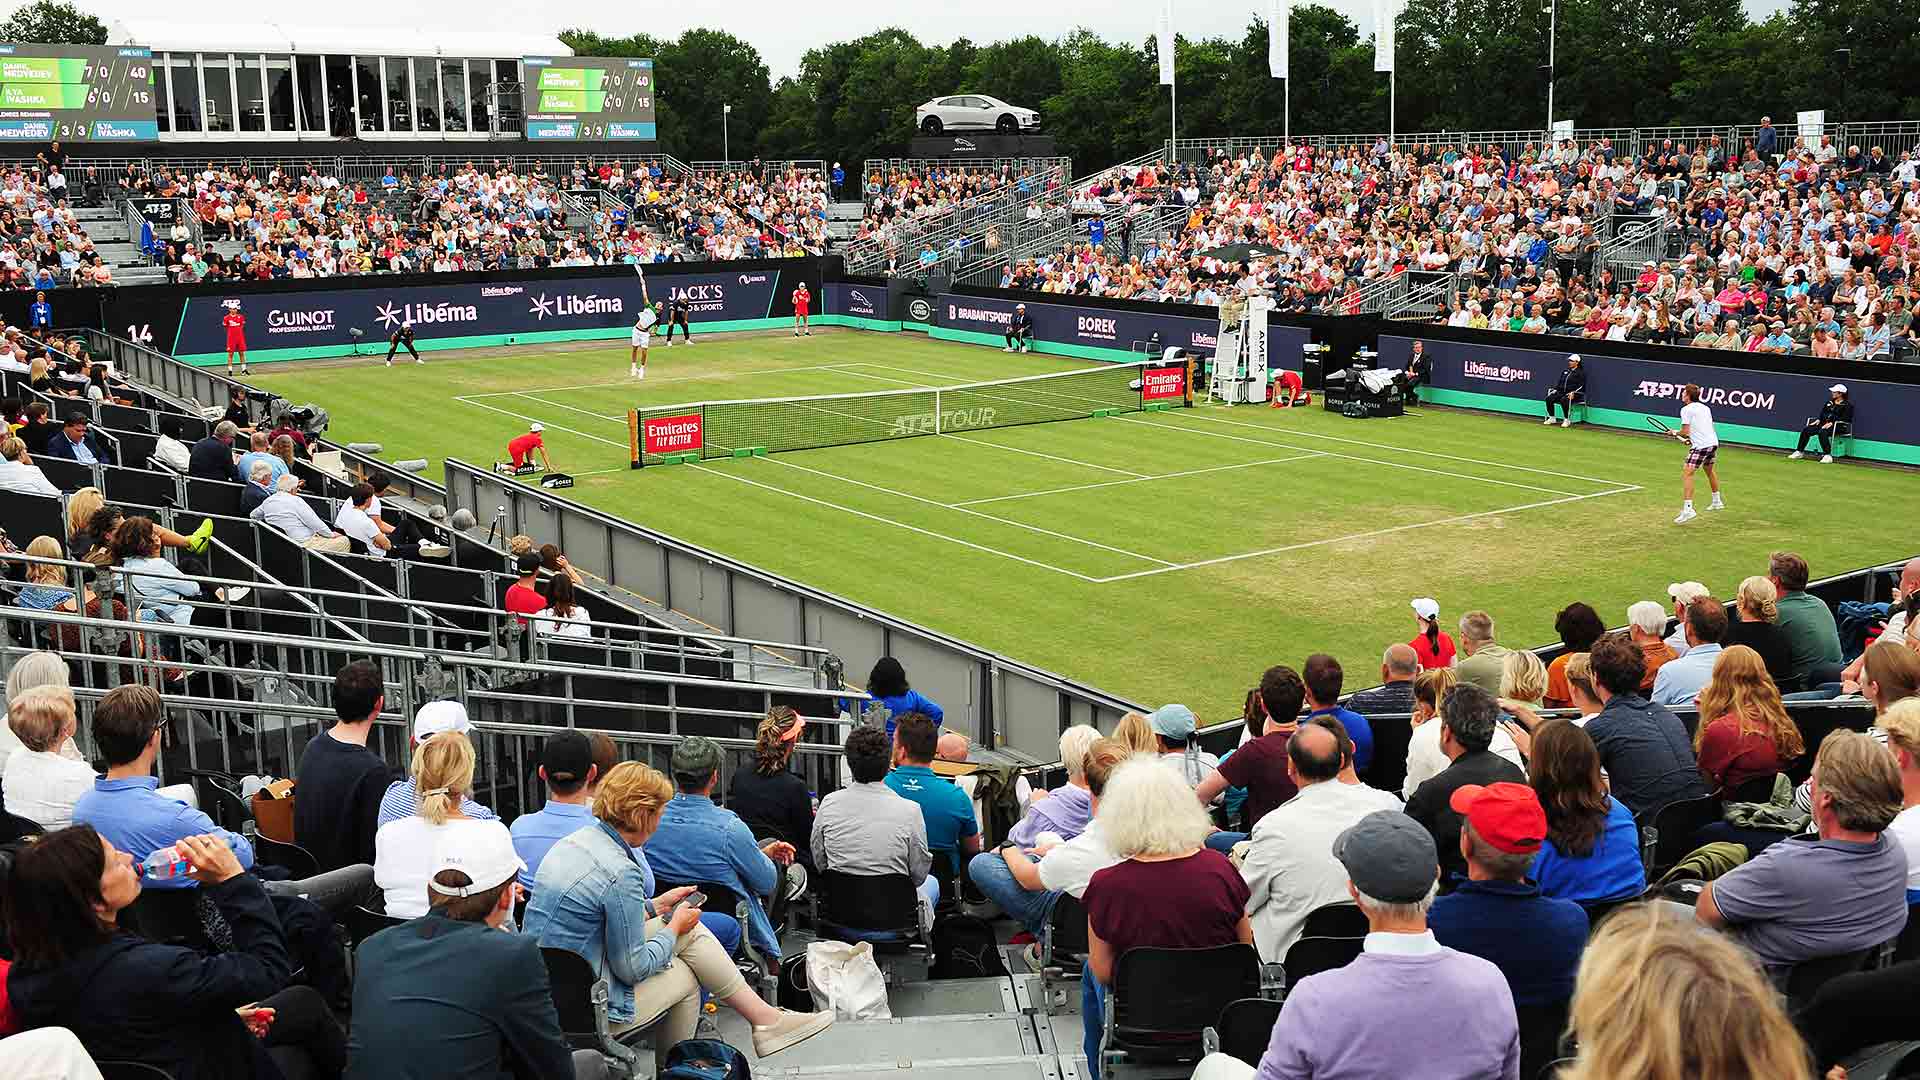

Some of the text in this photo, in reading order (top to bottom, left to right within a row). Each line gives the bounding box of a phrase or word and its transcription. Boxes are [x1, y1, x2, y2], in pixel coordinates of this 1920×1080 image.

[86, 66, 146, 79] 7 0 40
[603, 75, 649, 86] 7 0 40
[102, 92, 110, 103] 0
[133, 91, 149, 103] 15
[615, 98, 622, 107] 0
[638, 98, 650, 108] 15
[61, 126, 86, 136] 3 3
[97, 129, 136, 137] IVASHKA
[584, 126, 603, 136] 3 3
[143, 203, 172, 214] ATP
[700, 303, 723, 312] SPORTS
[267, 309, 335, 327] GUINOT
[958, 307, 1013, 324] BRABANTSPORT
[268, 324, 336, 334] PROFESSIONAL BEAUTY
[1078, 316, 1116, 334] BOREK
[127, 324, 152, 342] 14
[1145, 372, 1182, 386] Emirates
[1500, 365, 1531, 382] Open
[1674, 384, 1776, 410] TUR.COM
[941, 406, 997, 430] TOUR
[648, 422, 699, 437] Emirates
[656, 433, 692, 447] FLY BETTER
